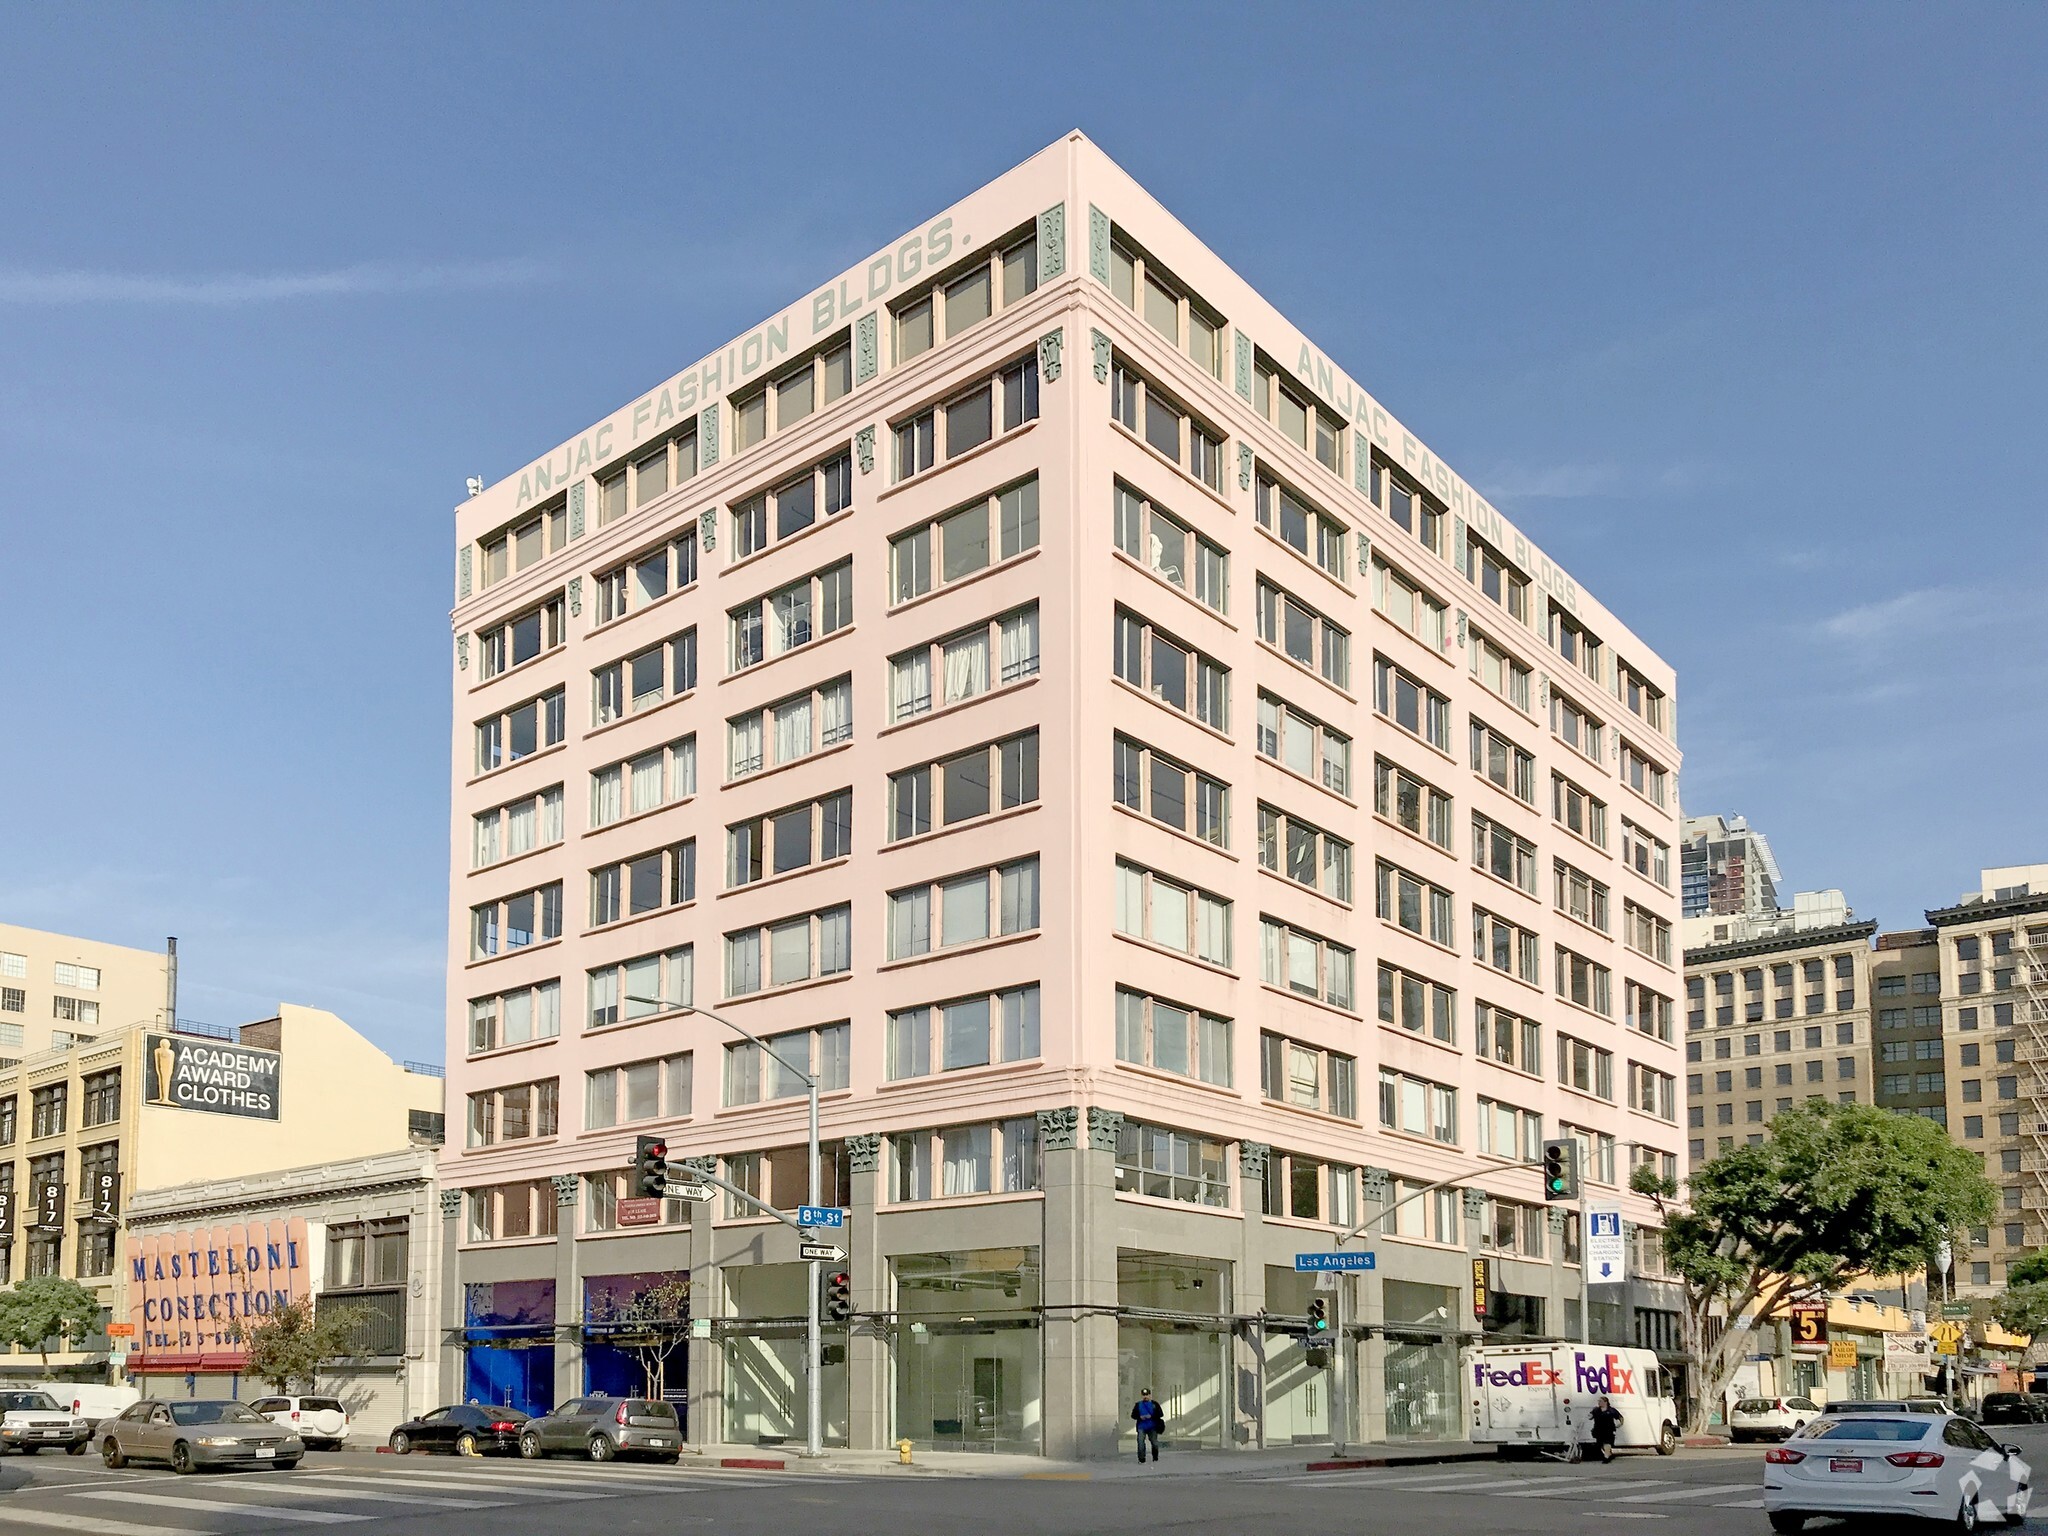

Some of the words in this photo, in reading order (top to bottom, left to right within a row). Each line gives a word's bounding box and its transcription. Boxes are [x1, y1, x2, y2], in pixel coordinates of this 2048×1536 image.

[516, 422, 614, 508] ANJAC
[632, 315, 789, 440] FASHION
[813, 217, 971, 335] BLDGS.
[1297, 342, 1389, 448] ANJAC
[1402, 431, 1504, 549] FASHION
[179, 1046, 277, 1075] ACADEMY
[177, 1064, 251, 1089] AWARD
[177, 1083, 271, 1110] CLOTHES
[46, 1186, 58, 1222] 817
[100, 1175, 113, 1213] 817
[685, 1187, 704, 1197] WAY
[803, 1209, 822, 1222] 8th
[826, 1212, 839, 1223] St
[132, 1241, 299, 1282] MASTELONI
[1299, 1256, 1319, 1267] Los
[1323, 1255, 1371, 1268] Angeles
[145, 1289, 288, 1322] CONECTION
[1474, 1361, 1565, 1387] FedEx
[1575, 1352, 1635, 1395] FedEx
